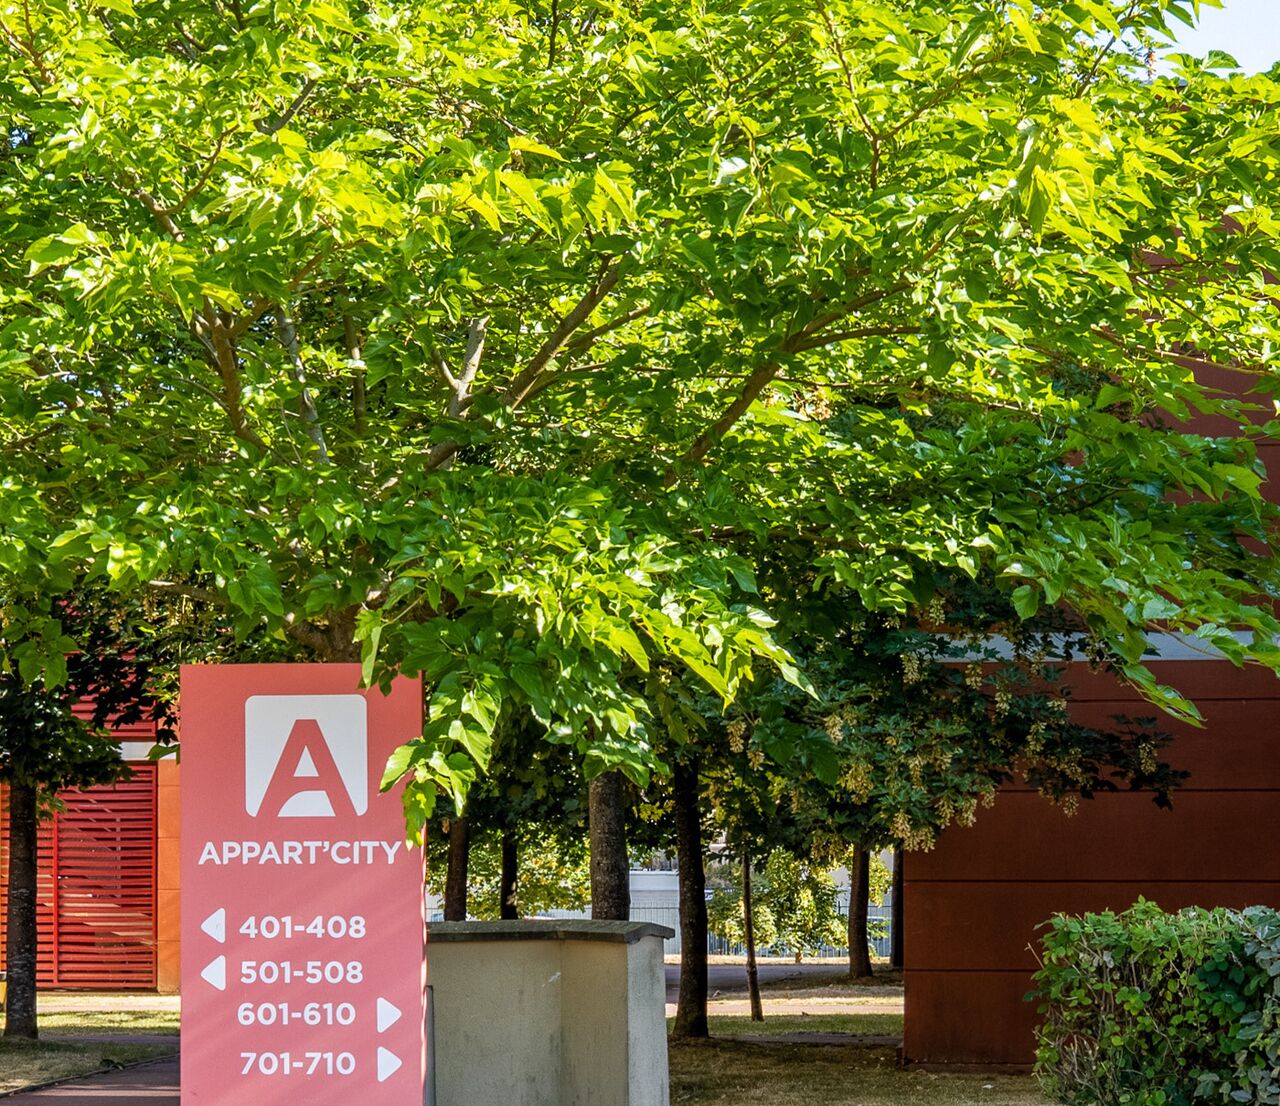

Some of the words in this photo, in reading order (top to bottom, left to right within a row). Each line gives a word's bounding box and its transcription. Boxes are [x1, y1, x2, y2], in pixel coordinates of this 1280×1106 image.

[238, 915, 367, 939] 401-408
[239, 960, 364, 984] 501-508
[237, 1002, 356, 1026] 601-610
[240, 1051, 356, 1076] 701-710
